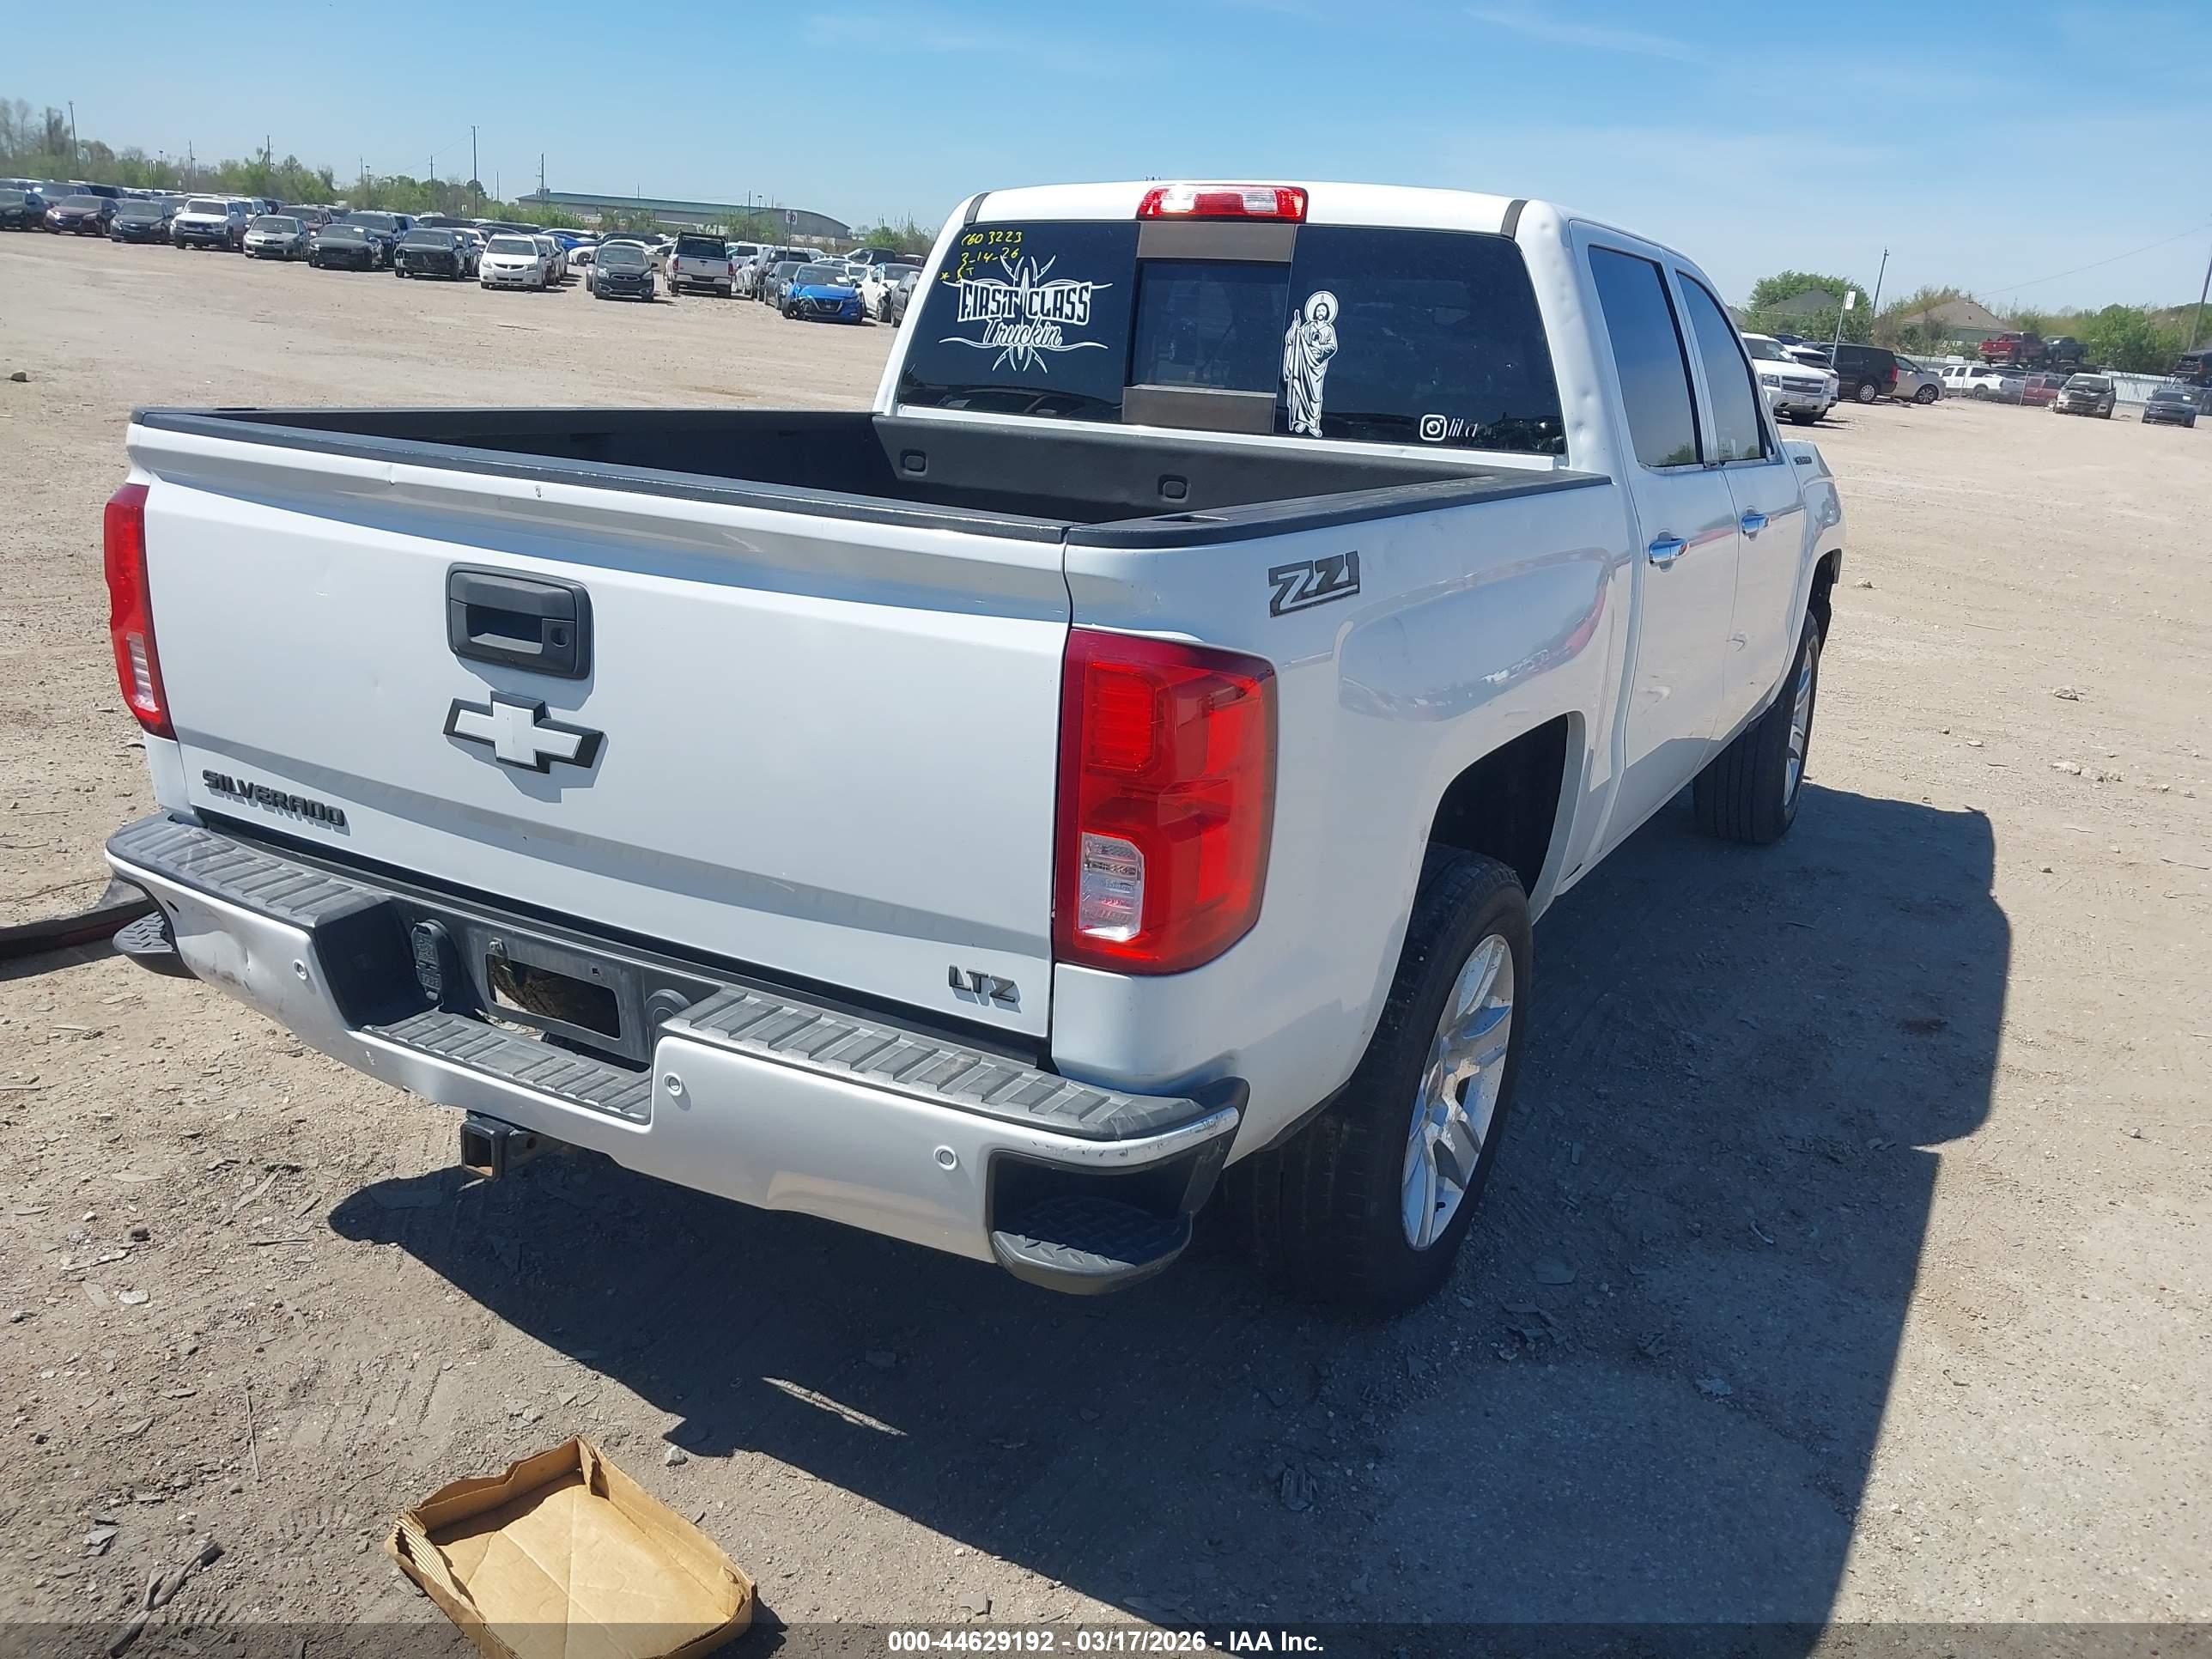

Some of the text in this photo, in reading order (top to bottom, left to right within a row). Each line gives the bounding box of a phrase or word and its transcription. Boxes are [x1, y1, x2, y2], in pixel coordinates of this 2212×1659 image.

[988, 231, 1023, 245] 3223
[958, 280, 1092, 325] FIRST CLASS
[984, 316, 1063, 348] Truckin
[202, 769, 345, 827] SILVERADO
[948, 964, 1017, 1003] LTZ
